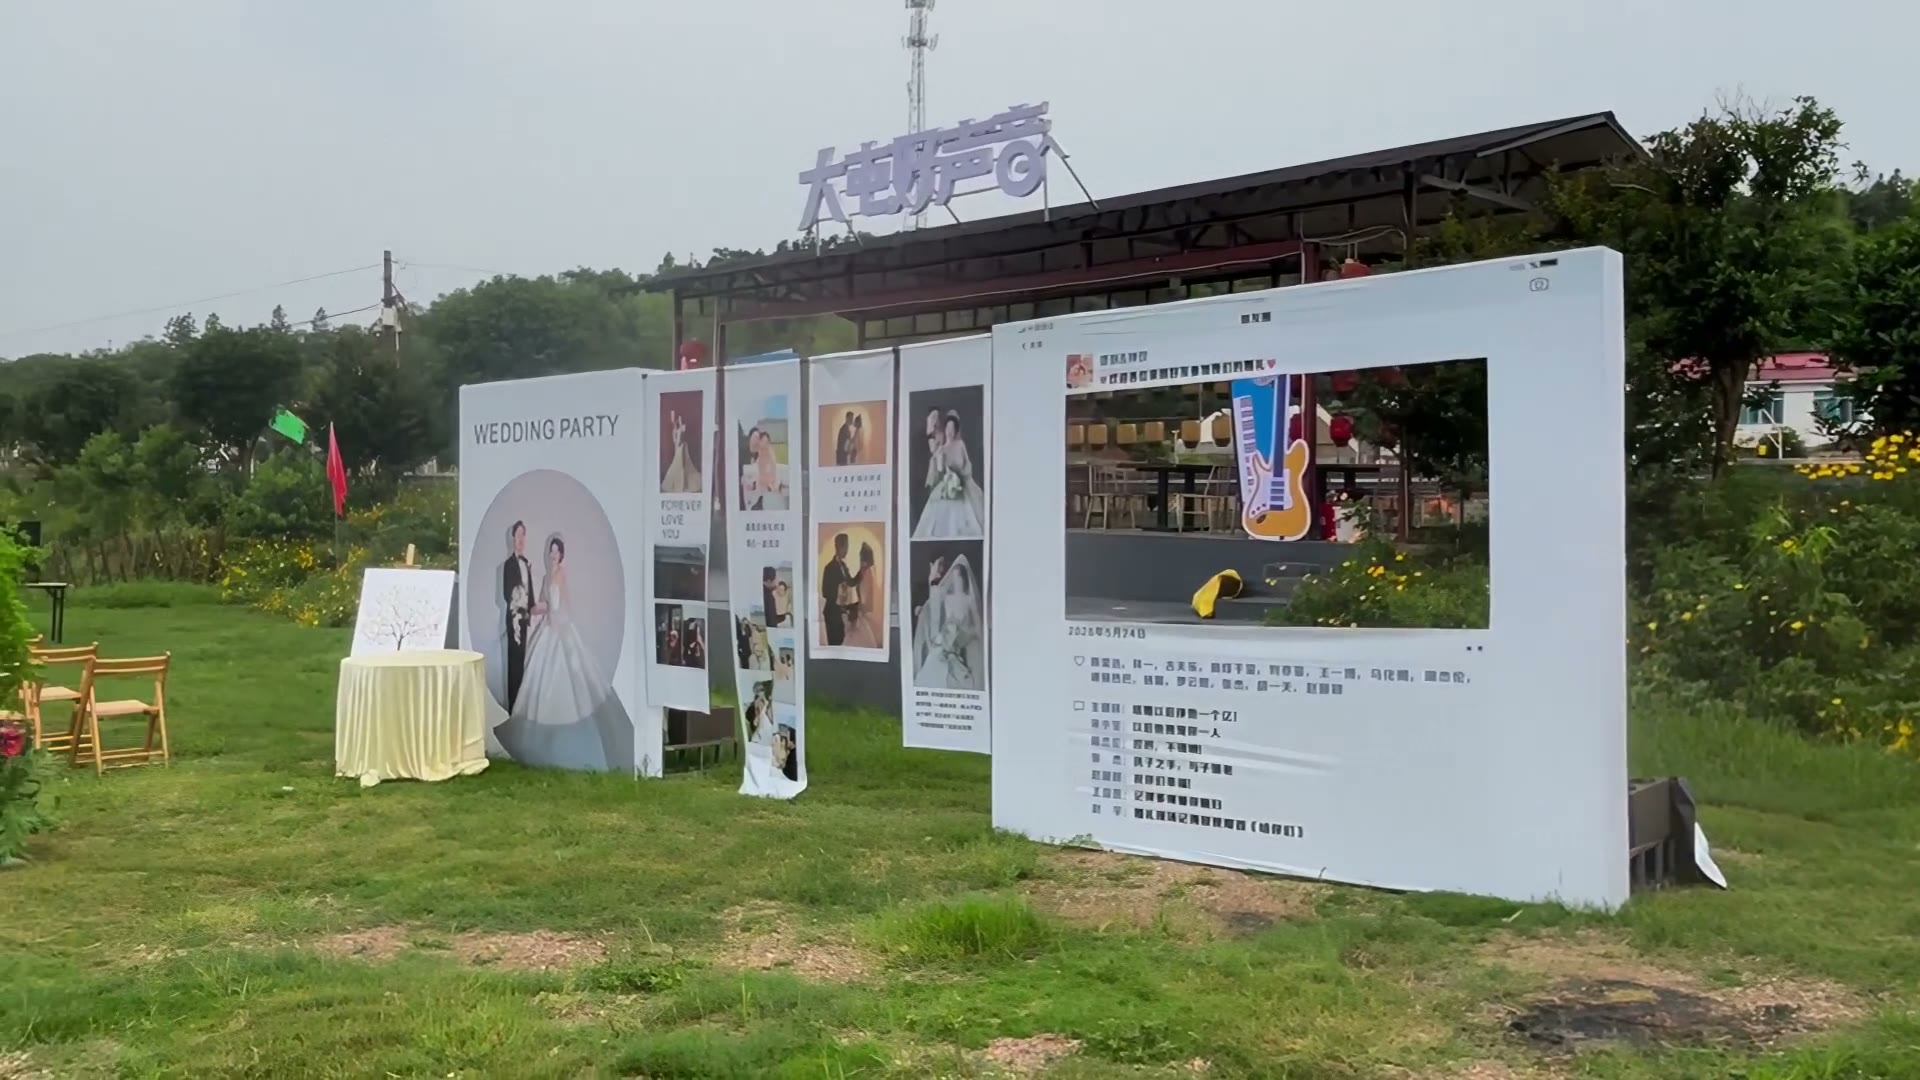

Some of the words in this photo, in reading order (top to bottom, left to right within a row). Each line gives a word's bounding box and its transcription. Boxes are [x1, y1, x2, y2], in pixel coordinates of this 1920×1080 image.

[474, 419, 555, 444] WEDDING
[560, 414, 619, 440] PARTY
[661, 514, 684, 525] LOVE
[662, 529, 680, 539] YOU
